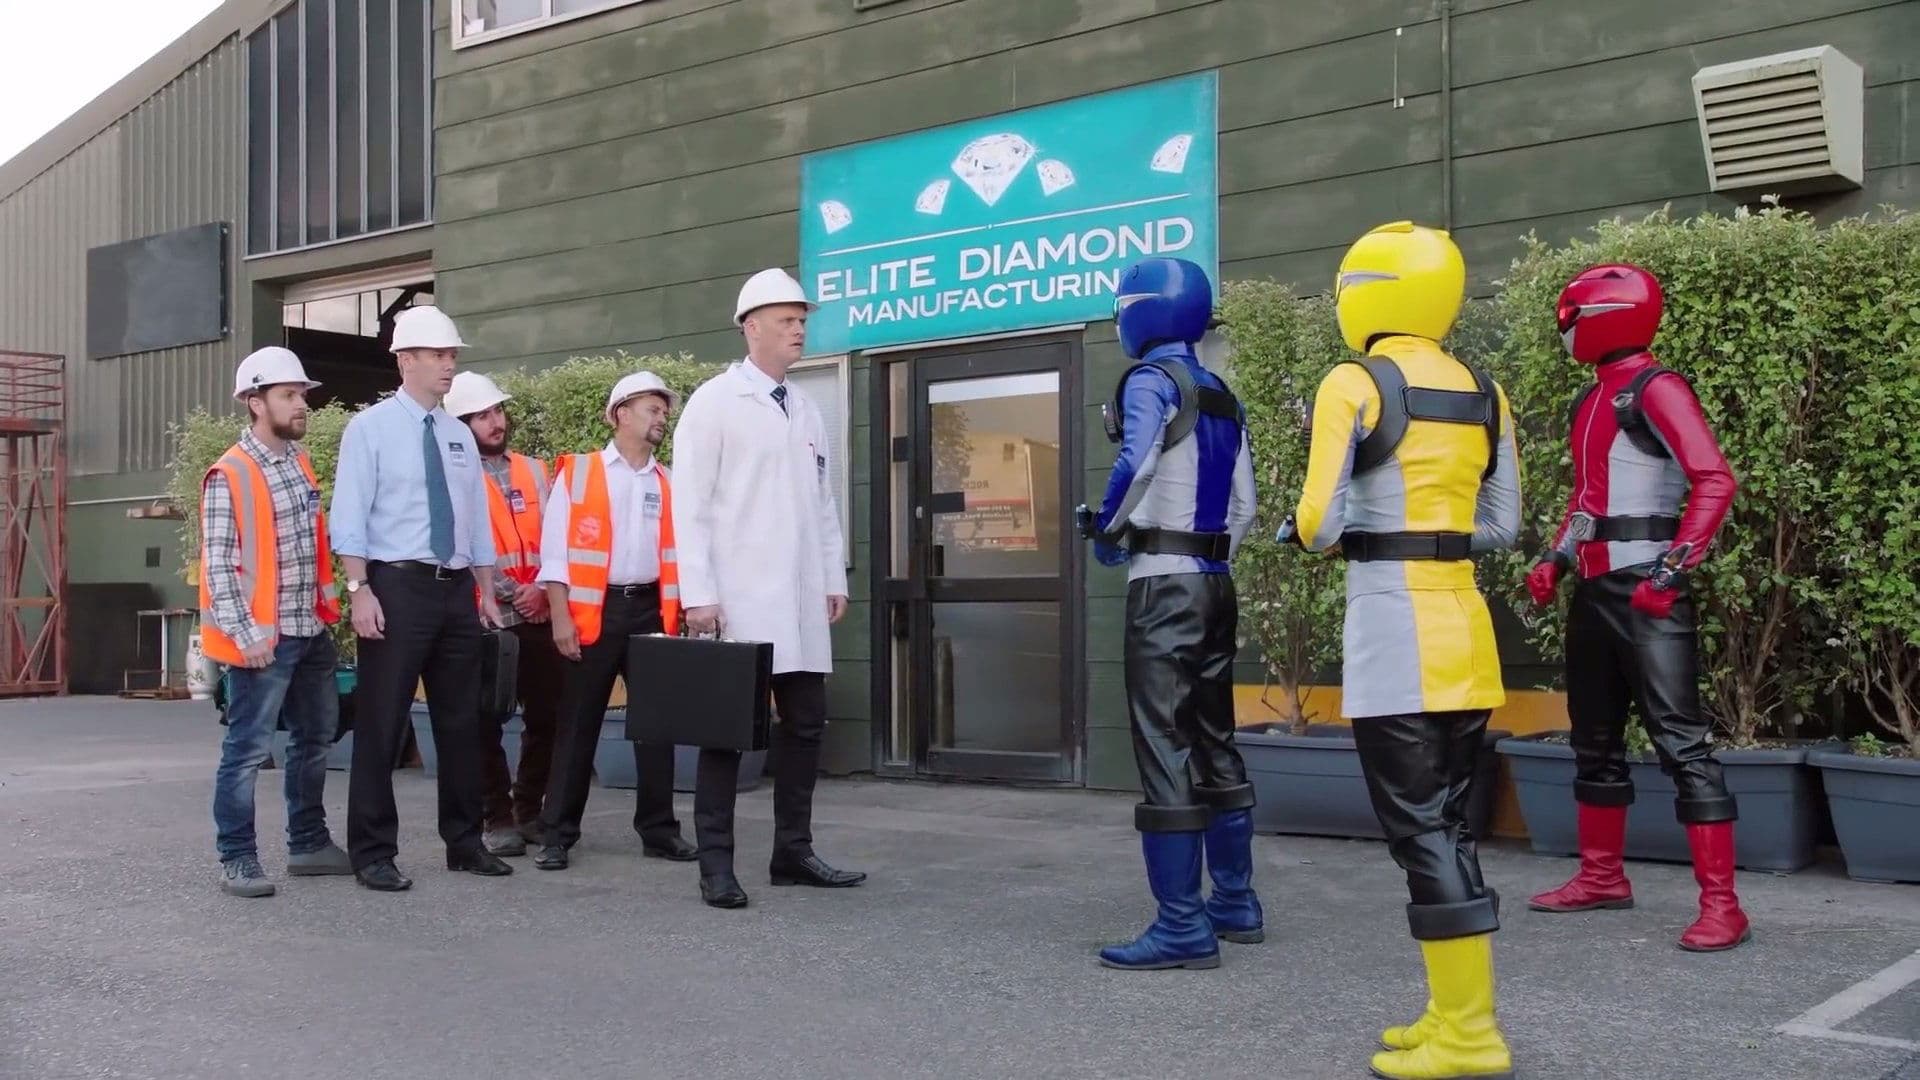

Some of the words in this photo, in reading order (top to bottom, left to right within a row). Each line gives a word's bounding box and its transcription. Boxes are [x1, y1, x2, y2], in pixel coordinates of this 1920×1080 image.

[817, 255, 936, 303] ELITE
[958, 216, 1194, 282] DIAMOND
[847, 267, 1120, 328] MANUFACTURIN
